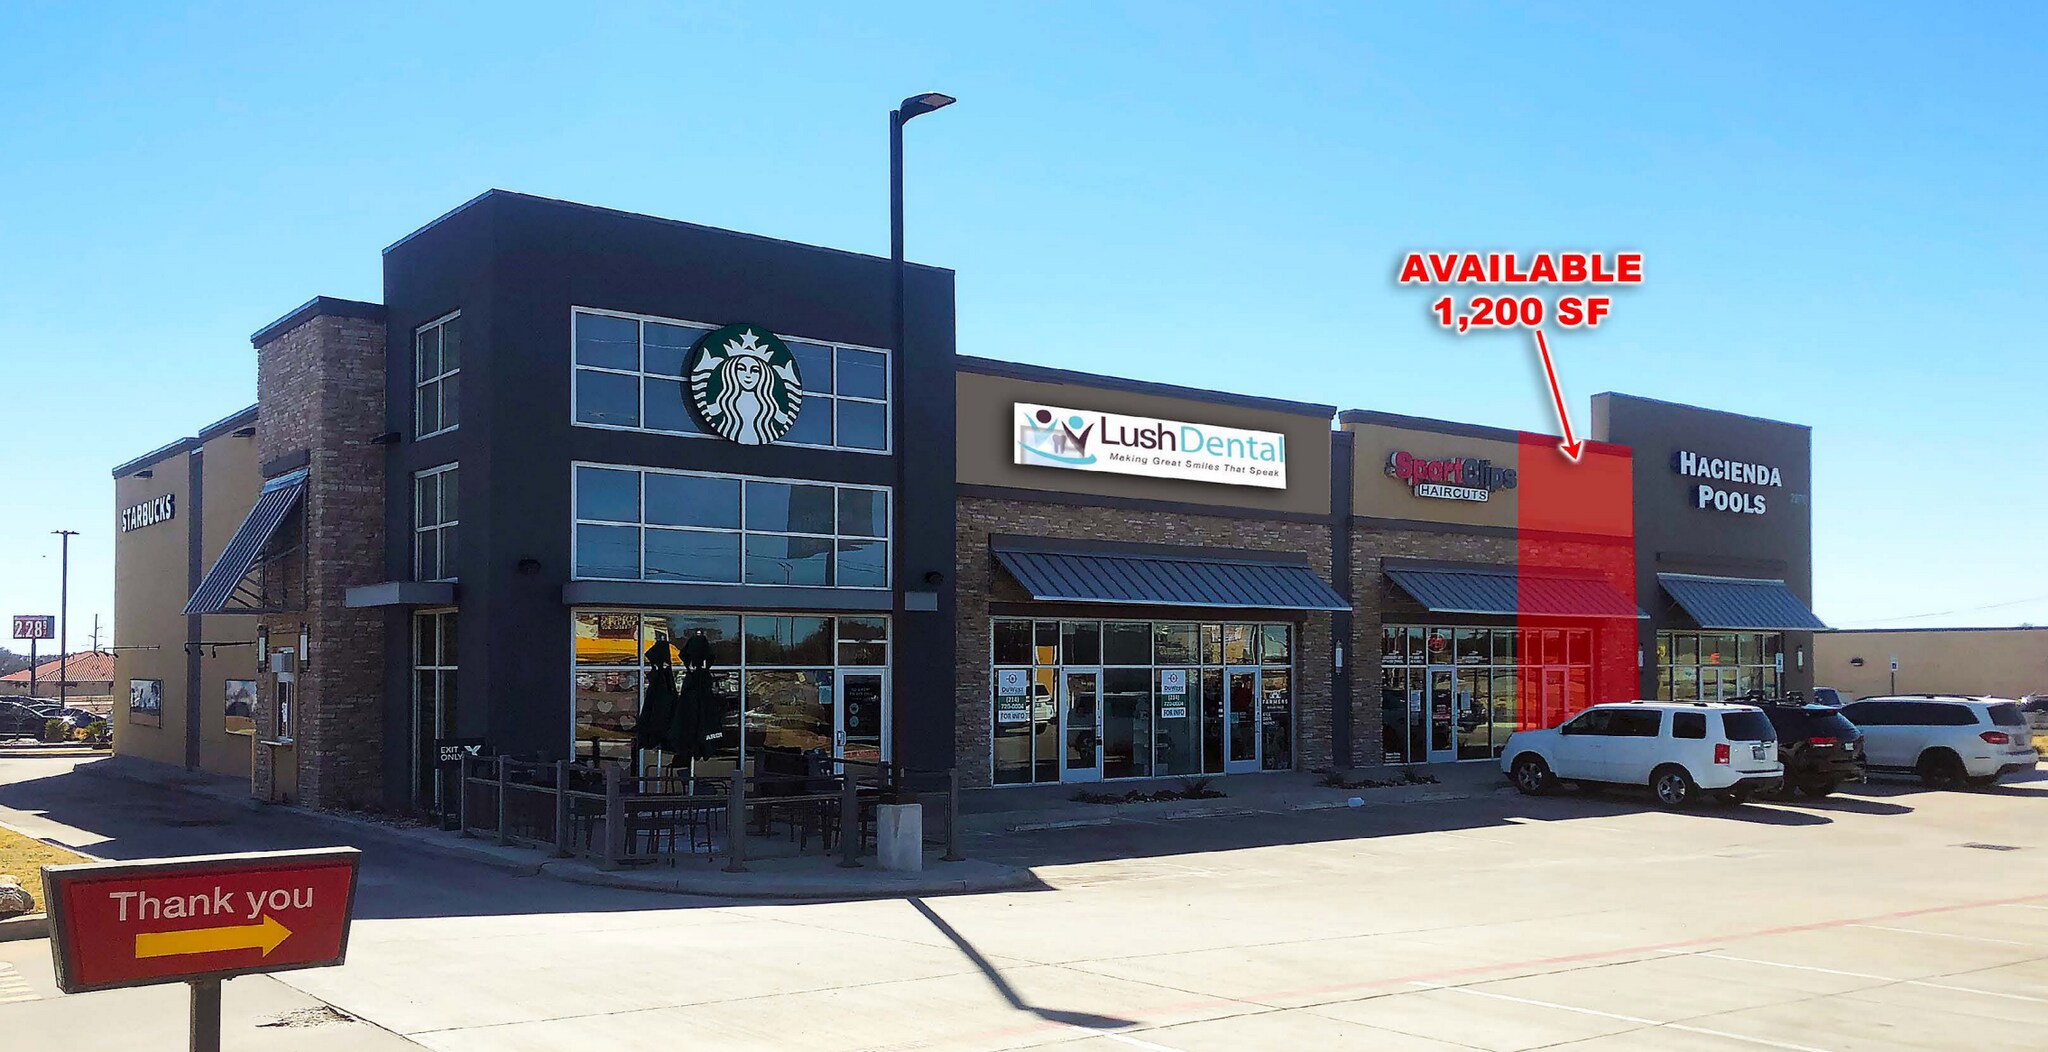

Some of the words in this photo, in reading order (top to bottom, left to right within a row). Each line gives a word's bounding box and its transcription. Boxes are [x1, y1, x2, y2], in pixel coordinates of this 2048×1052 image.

[1109, 452, 1148, 466] Making
[1152, 457, 1182, 468] Great
[1185, 460, 1220, 471] Smiles
[1224, 464, 1246, 473] That
[1249, 466, 1280, 477] Speak
[1680, 450, 1782, 487] HACIENDA
[1420, 485, 1488, 501] HAIRCUTS
[1698, 484, 1767, 515] POOLS
[122, 494, 171, 532] STARBUCKS
[440, 746, 459, 754] EXIT
[440, 753, 463, 762] ONLY
[109, 886, 235, 922] Thank
[246, 887, 314, 920] you
